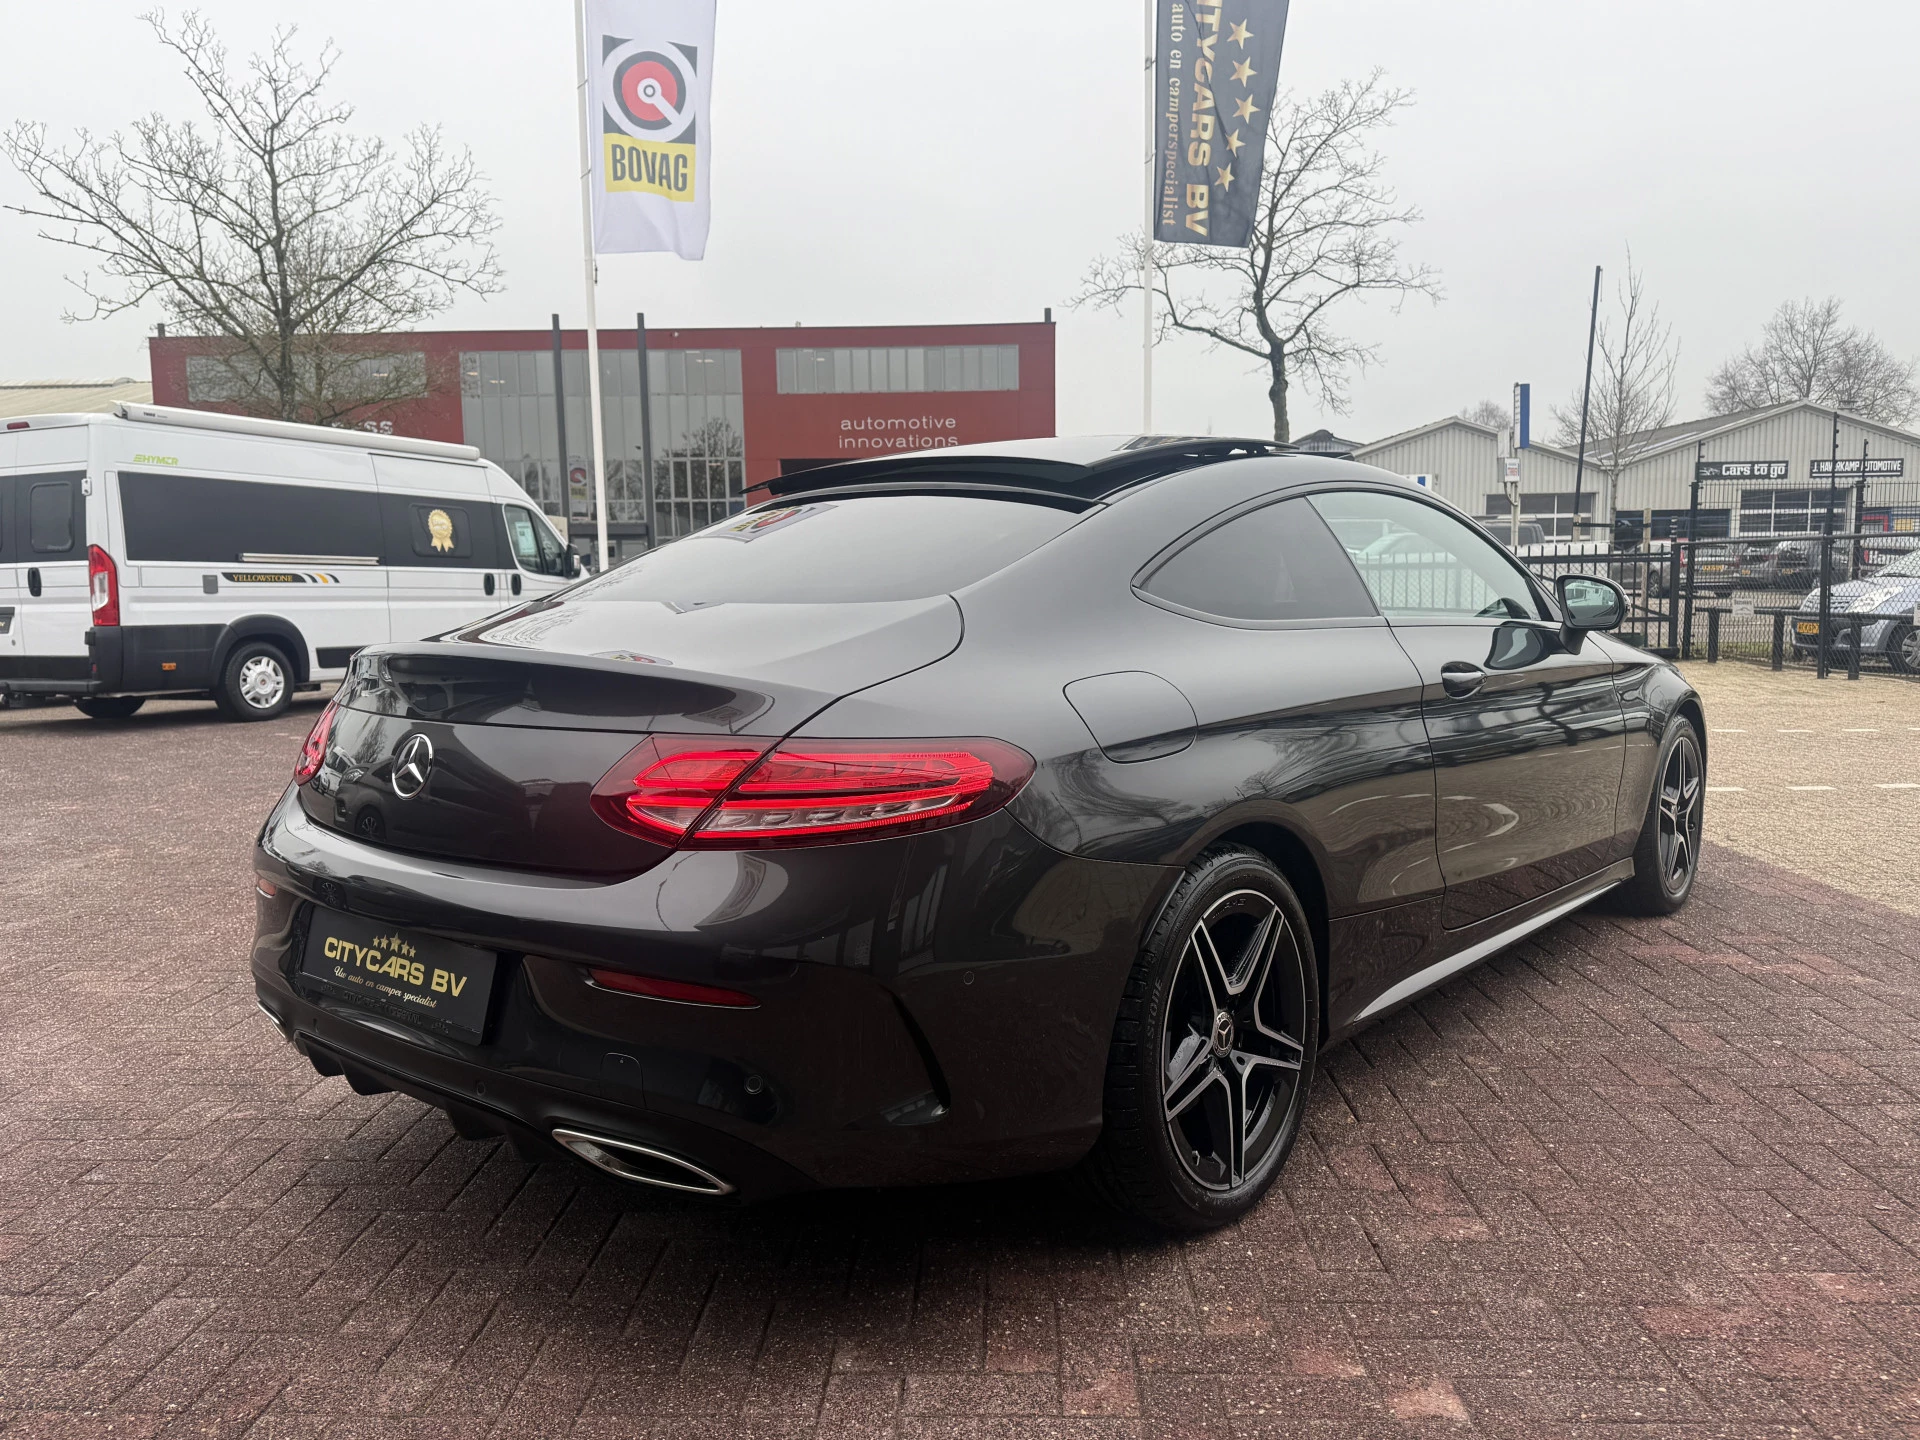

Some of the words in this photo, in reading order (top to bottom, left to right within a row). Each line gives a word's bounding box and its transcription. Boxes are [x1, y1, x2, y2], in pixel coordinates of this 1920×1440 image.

[1170, 3, 1186, 42] auto
[1169, 49, 1182, 69] en
[1187, 0, 1222, 166] ITYCARS
[611, 144, 687, 192] BOVAG
[1162, 77, 1181, 225] camperspecialist
[1186, 183, 1209, 236] BV
[840, 416, 956, 430] automotive
[838, 434, 959, 449] innovations
[1722, 463, 1752, 476] Cars
[1754, 463, 1769, 475] to
[1769, 463, 1787, 478] go
[1820, 460, 1860, 472] HAVRKAMP
[232, 573, 293, 582] YELLOWSTONE
[324, 936, 425, 986] CITYCARS
[431, 968, 468, 997] BV
[347, 975, 364, 984] auto
[375, 983, 403, 997] camper
[402, 991, 437, 1009] specialist
